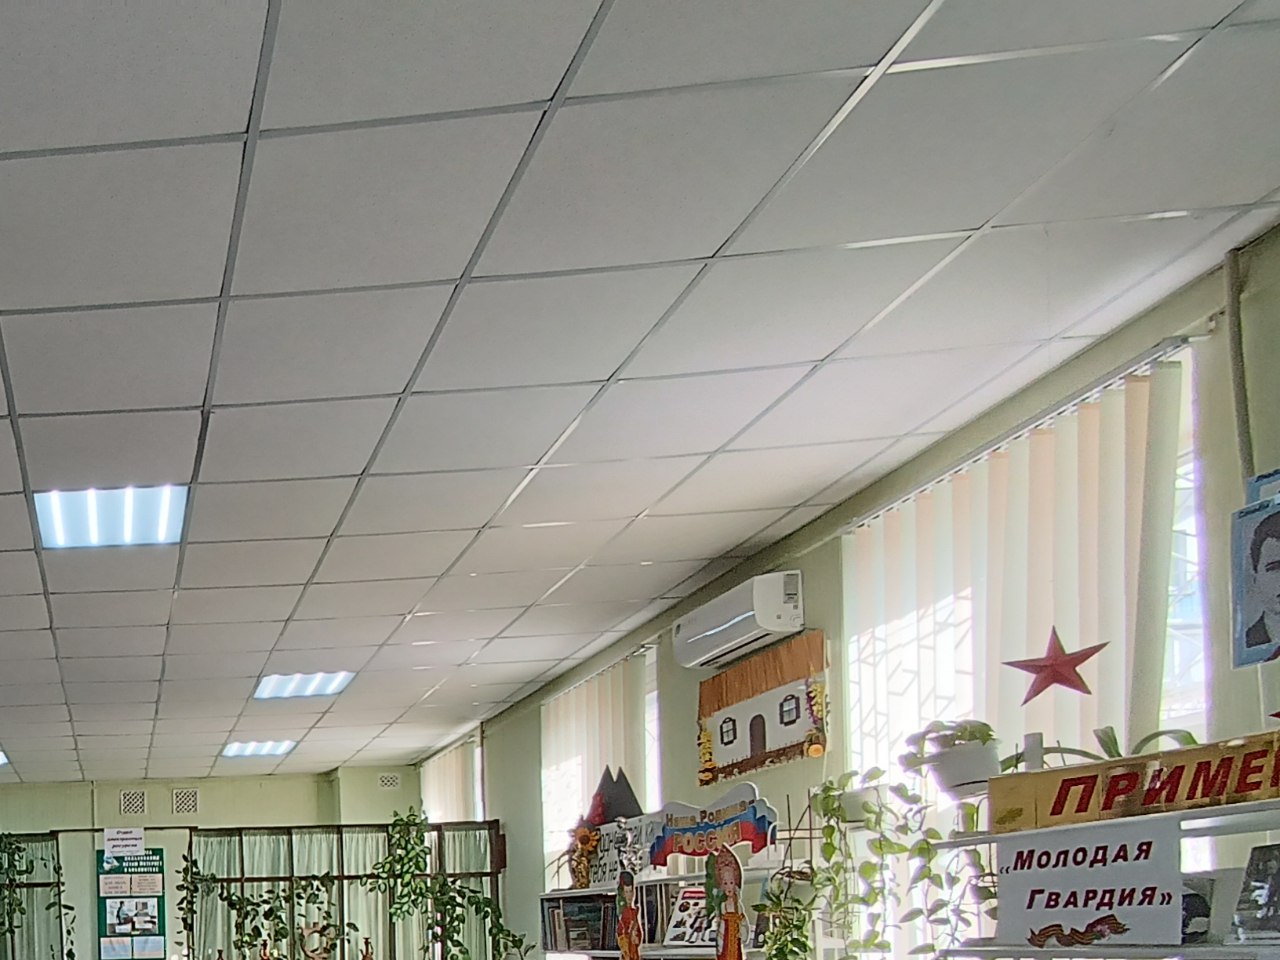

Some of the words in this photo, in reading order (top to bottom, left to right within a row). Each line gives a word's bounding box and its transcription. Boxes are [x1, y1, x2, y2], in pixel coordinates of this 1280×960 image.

[699, 800, 747, 826] Родина
[672, 819, 742, 853] РОССИЯ
[1025, 886, 1173, 911] ГВАРДИЯ»
